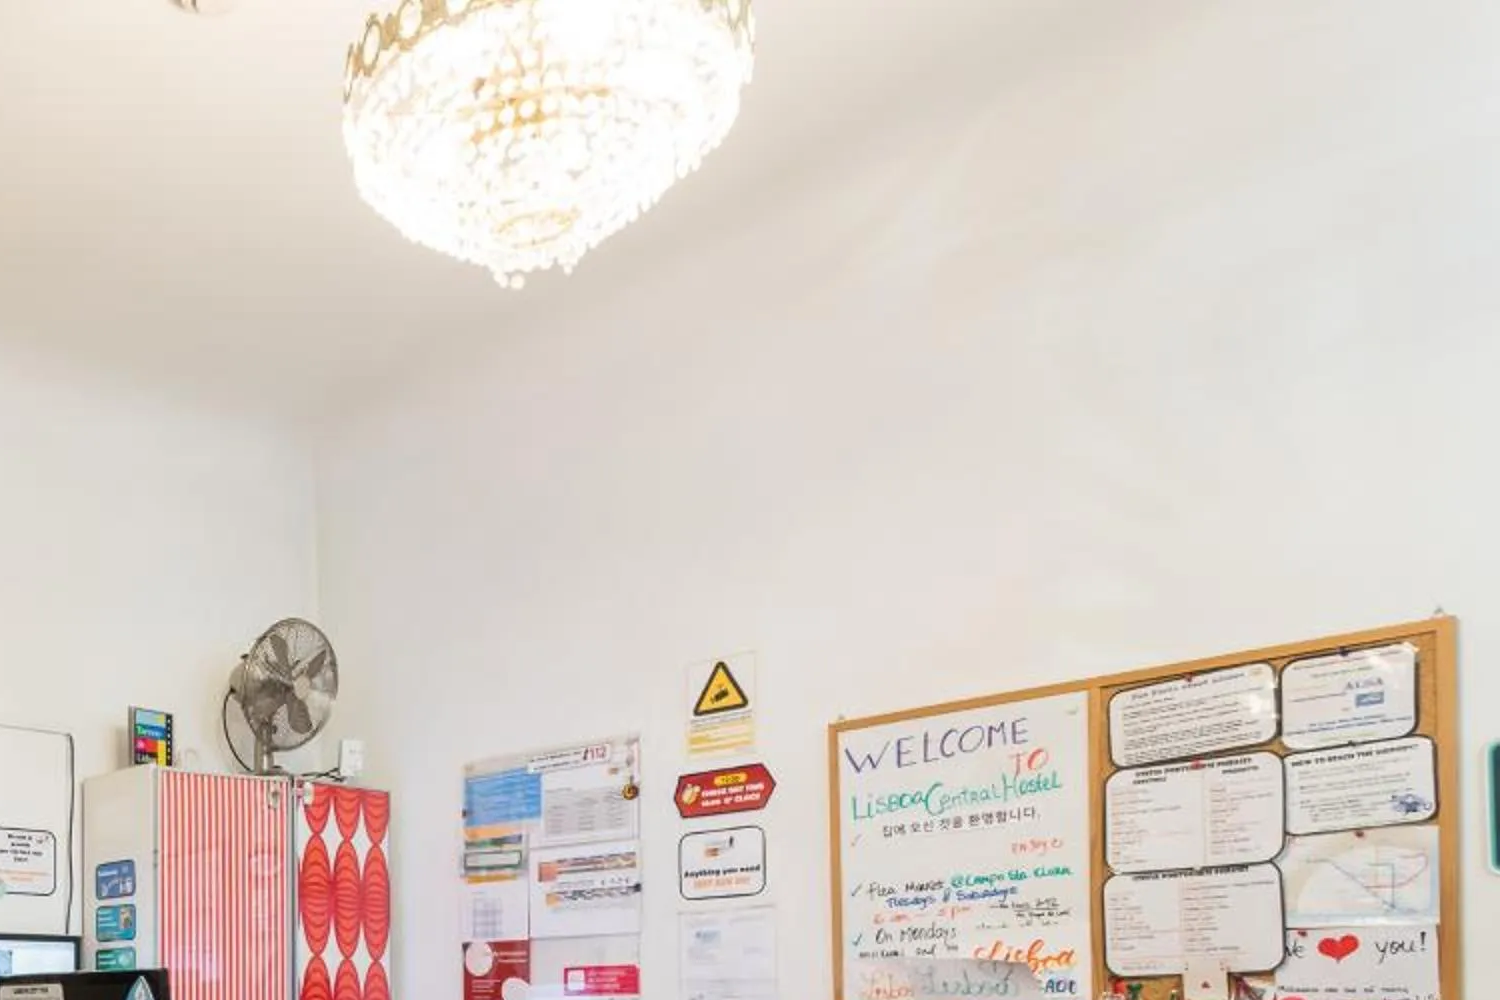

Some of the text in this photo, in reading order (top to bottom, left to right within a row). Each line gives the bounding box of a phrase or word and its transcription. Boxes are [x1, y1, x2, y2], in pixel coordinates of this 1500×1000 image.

[845, 717, 1029, 774] WELCOME
[1009, 748, 1049, 778] TO
[1375, 930, 1428, 964] you!
